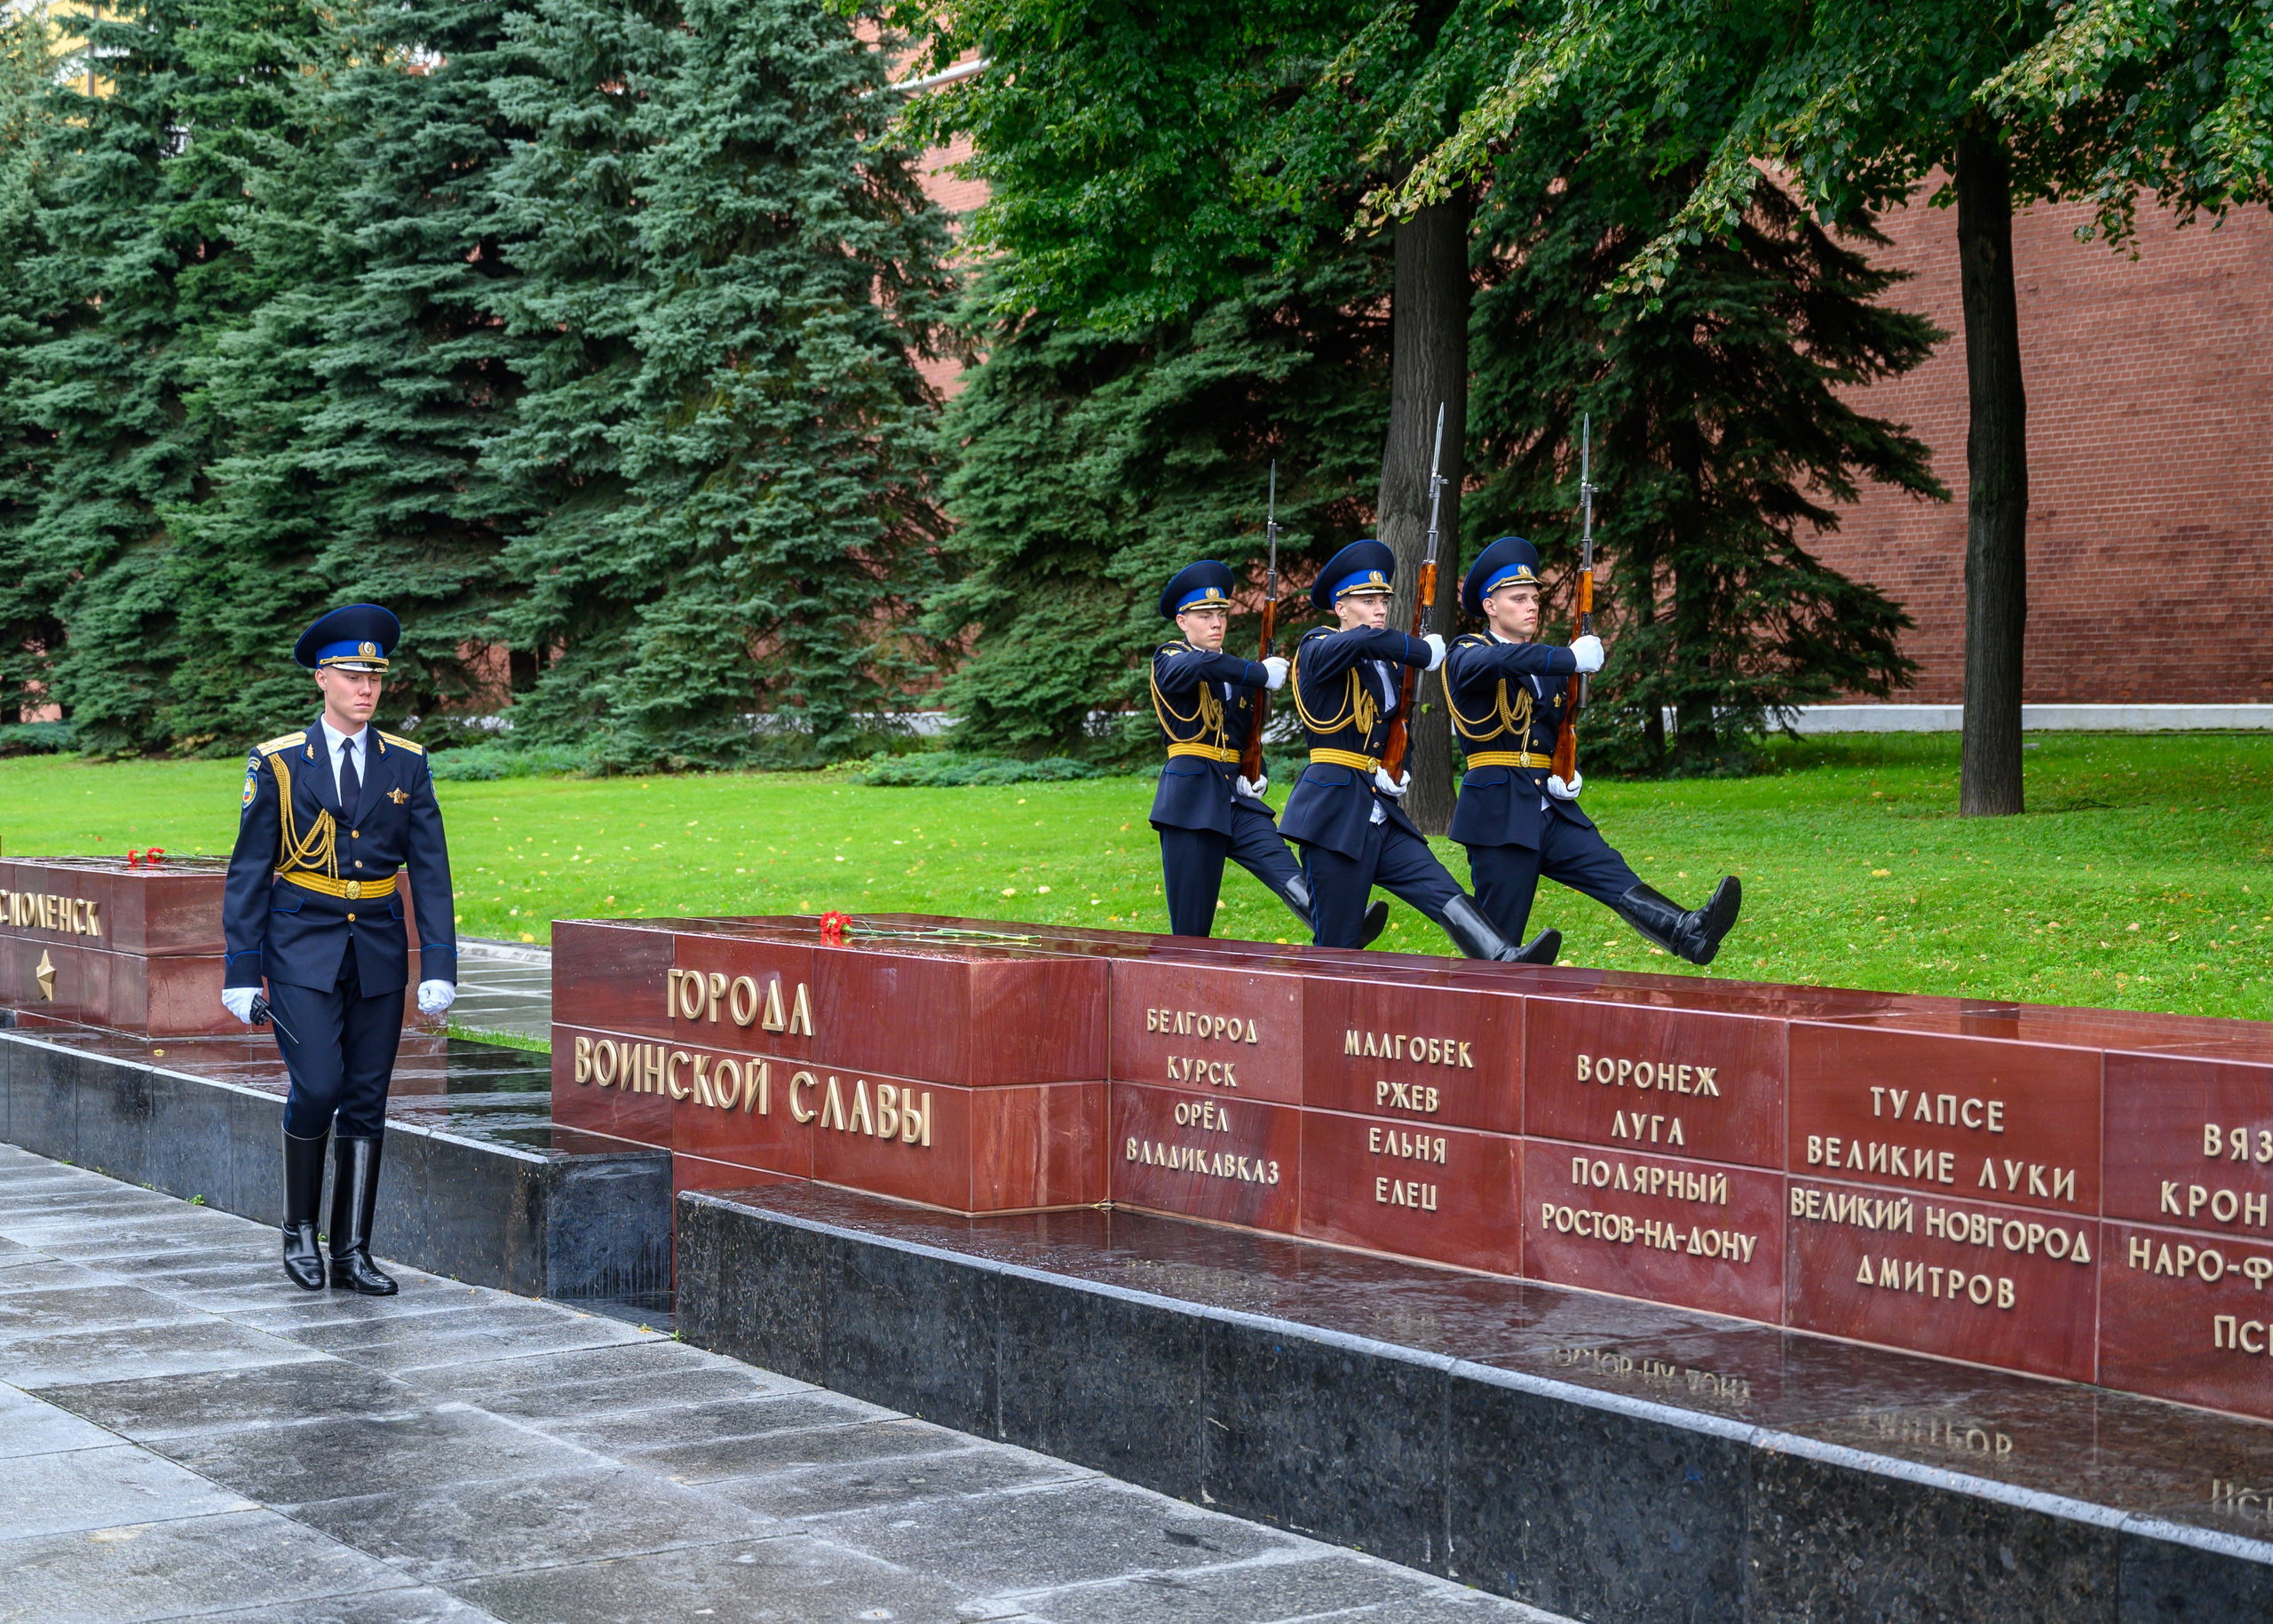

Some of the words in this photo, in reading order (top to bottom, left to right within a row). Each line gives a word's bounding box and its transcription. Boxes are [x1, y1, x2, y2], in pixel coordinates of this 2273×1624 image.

[0, 889, 100, 937] СМОЛЕНСК
[667, 968, 814, 1037] ГОРОДА
[1146, 1008, 1258, 1045] БЕЛГОРОД
[1344, 1029, 1474, 1068] МАЛГОБЕК
[574, 1035, 771, 1115] ВОИНСКОЙ
[789, 1070, 933, 1147] СЛАВЫ
[1167, 1056, 1237, 1088] КУРСК
[1577, 1054, 1721, 1097] ВОРОНЕЖ
[1175, 1101, 1229, 1132] ОРЁЛ
[1376, 1081, 1439, 1113] РЖЕВ
[1870, 1086, 2005, 1133] ТУАПСЕ
[1368, 1127, 1447, 1164] ЕЛЬНЯ
[1611, 1110, 1684, 1146] ЛУГА
[2204, 1123, 2273, 1163] ВЯЗ
[1126, 1137, 1279, 1185] ВЛАДИКАВКАЗ
[1572, 1157, 1728, 1206] ПОЛЯРНЫЙ
[1808, 1135, 1954, 1184] ВЕЛИКИЕ
[1978, 1157, 2076, 1202] ЛУКИ
[1375, 1176, 1437, 1211] ЕЛЕЦ
[2160, 1180, 2268, 1227] КРОН
[1542, 1203, 1757, 1264] РОСТОВ-НА-ДОНУ
[1791, 1187, 1914, 1233] ВЕЛИКИЙ
[1926, 1206, 2092, 1264] НОВГОРОД
[1857, 1254, 2016, 1310] ДМИТРОВ
[2128, 1236, 2273, 1290] НАРО-Ф
[2214, 1314, 2273, 1357] ПС
